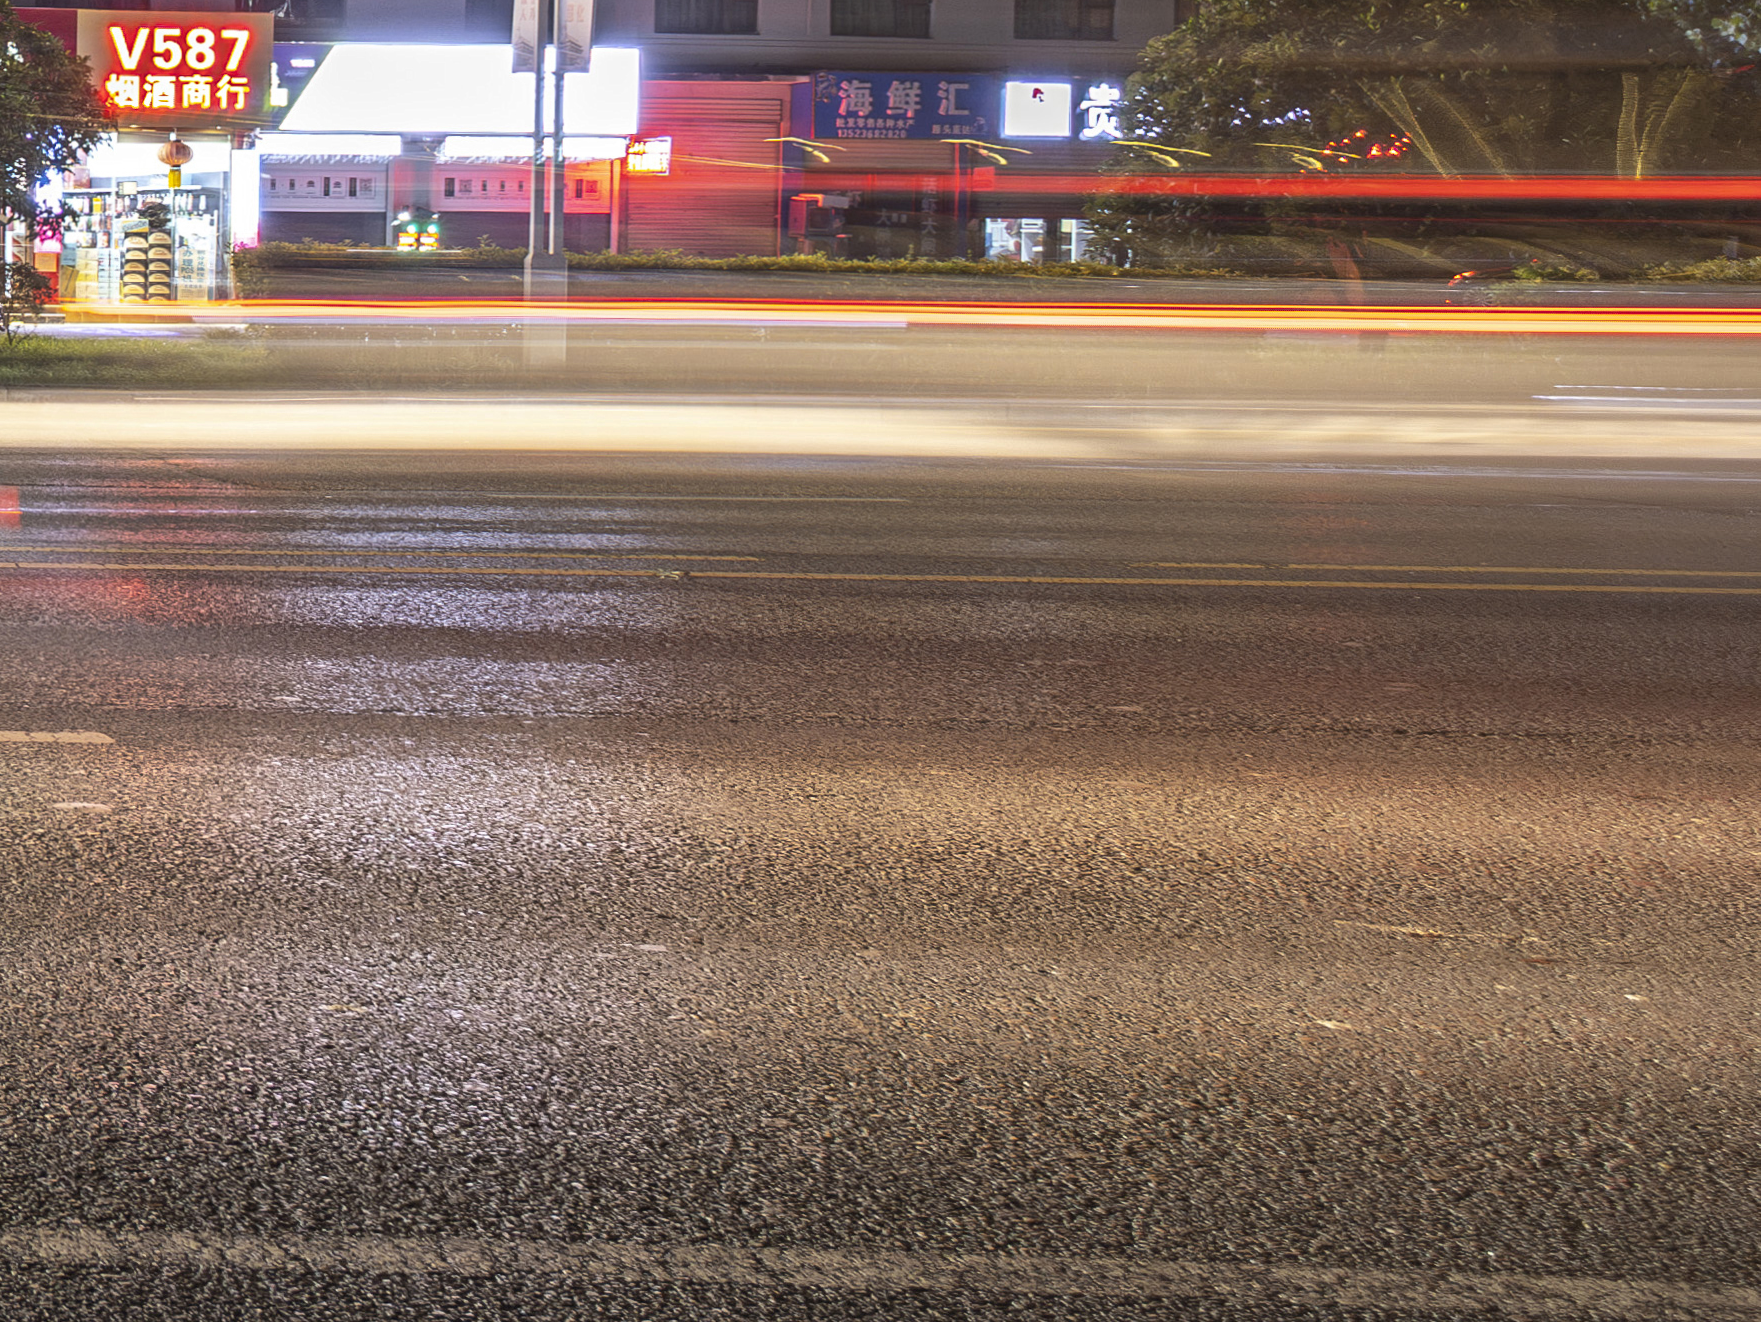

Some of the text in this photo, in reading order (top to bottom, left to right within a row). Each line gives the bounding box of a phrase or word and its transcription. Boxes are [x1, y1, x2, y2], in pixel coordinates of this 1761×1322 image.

[108, 25, 250, 72] V587
[104, 73, 251, 110] 烟酒商行
[837, 80, 971, 118] 海鲜汇
